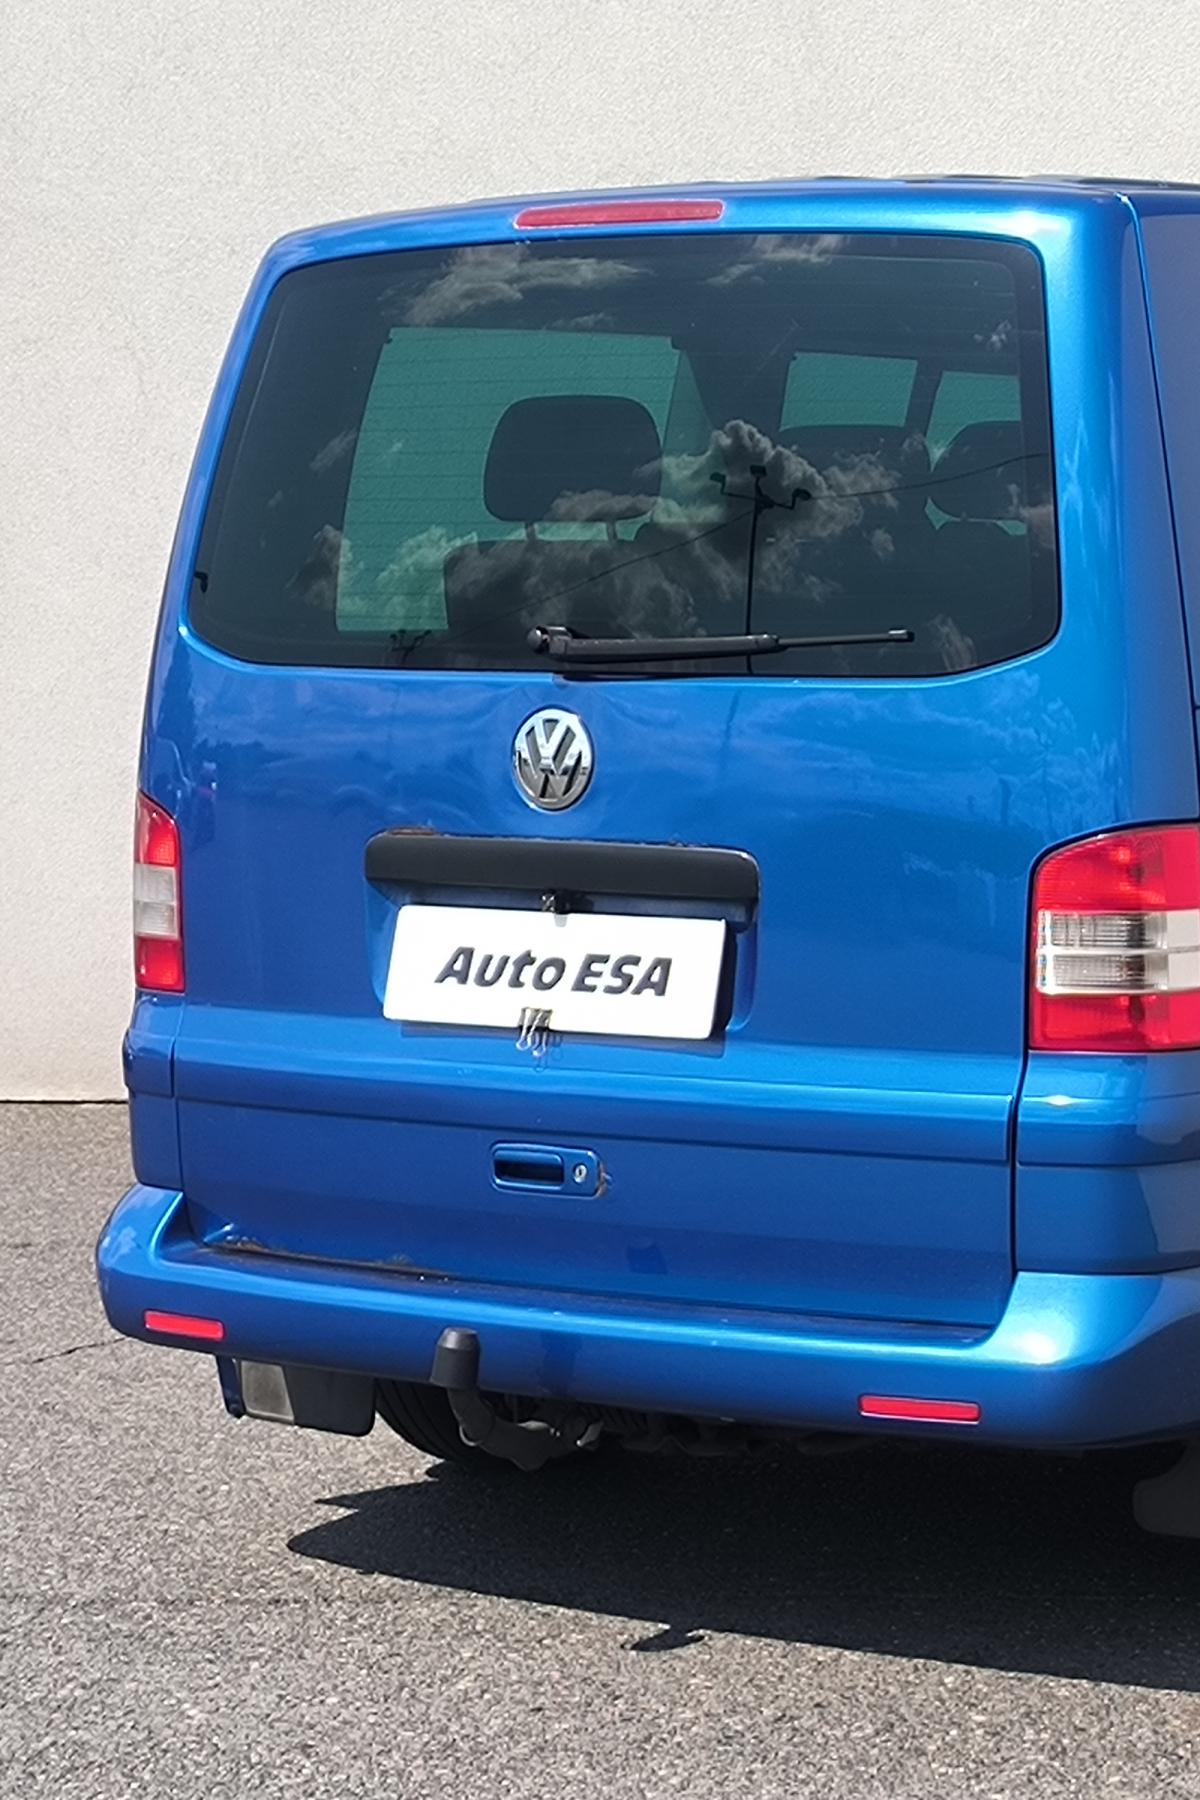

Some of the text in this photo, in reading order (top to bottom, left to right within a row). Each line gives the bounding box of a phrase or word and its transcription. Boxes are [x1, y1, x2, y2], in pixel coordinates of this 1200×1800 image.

[516, 710, 592, 807] VW
[434, 946, 673, 997] Auto ESA
